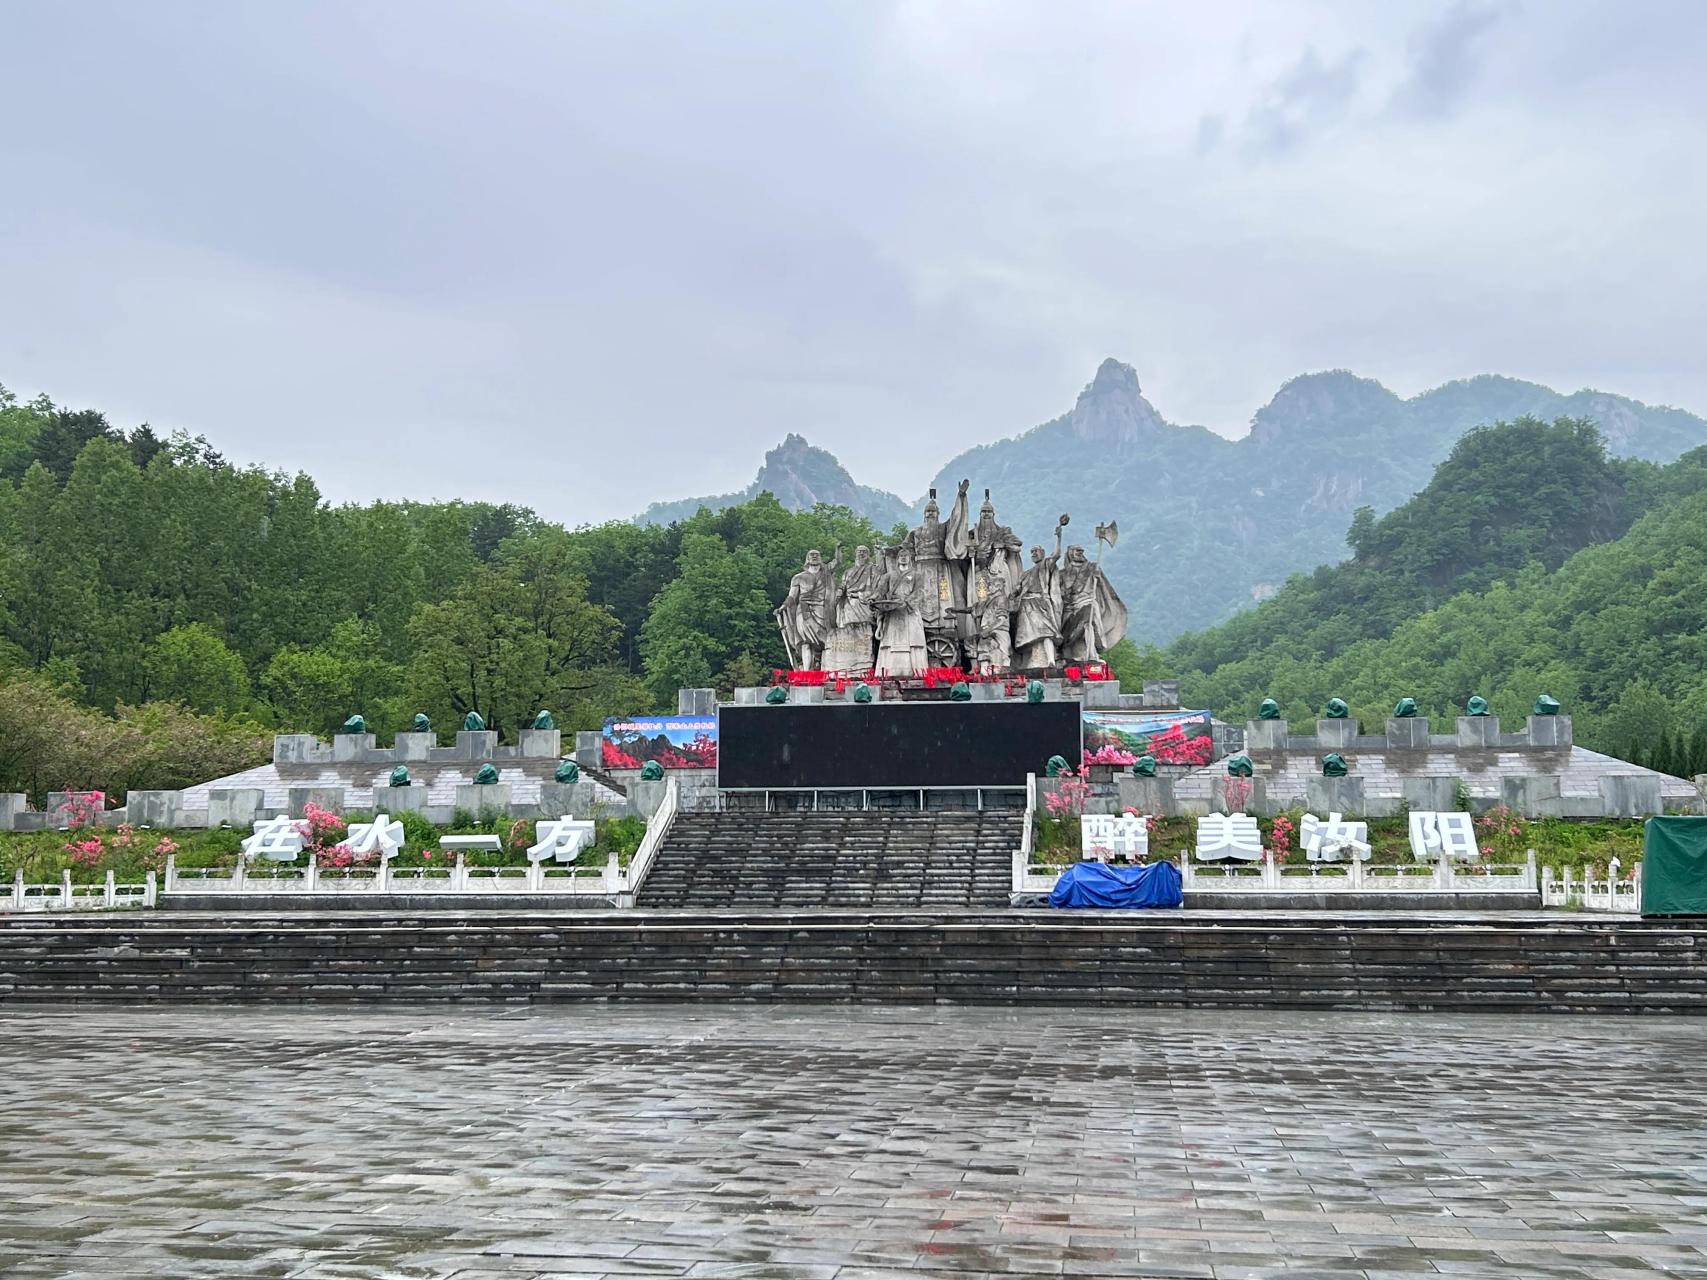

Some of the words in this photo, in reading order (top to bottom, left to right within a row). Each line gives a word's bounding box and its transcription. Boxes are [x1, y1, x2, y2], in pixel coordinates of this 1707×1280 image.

[241, 814, 596, 863] 在水一方
[1081, 811, 1480, 862] 醉美汝阳
